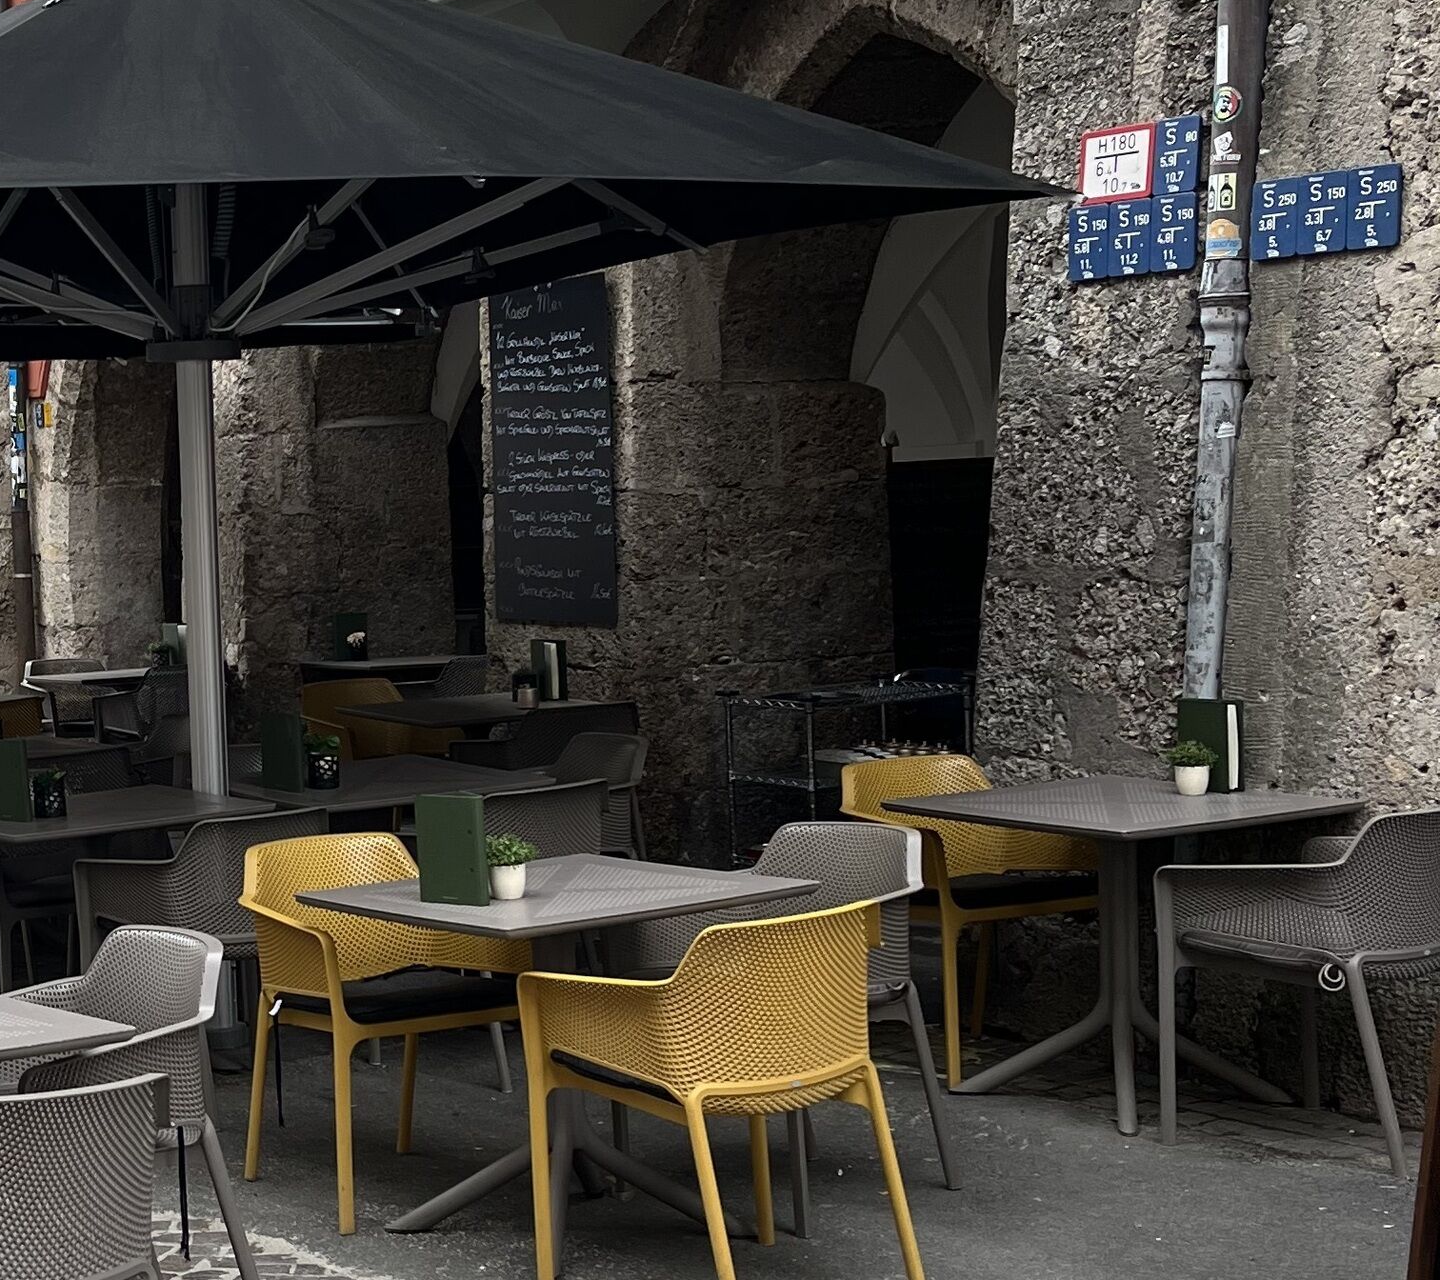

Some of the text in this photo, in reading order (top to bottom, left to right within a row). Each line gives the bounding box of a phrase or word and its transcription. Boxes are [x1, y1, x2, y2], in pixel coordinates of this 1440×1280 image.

[1165, 128, 1198, 145] S 80
[1165, 170, 1185, 184] 10.7
[1310, 183, 1346, 201] S 150
[1360, 177, 1398, 195] S 250
[1263, 190, 1297, 208] S 250
[1119, 210, 1150, 227] S 150
[1161, 204, 1194, 221] S 150
[1078, 215, 1107, 233] S 150
[1316, 229, 1333, 242] 6.7
[501, 295, 532, 320] Kaiser
